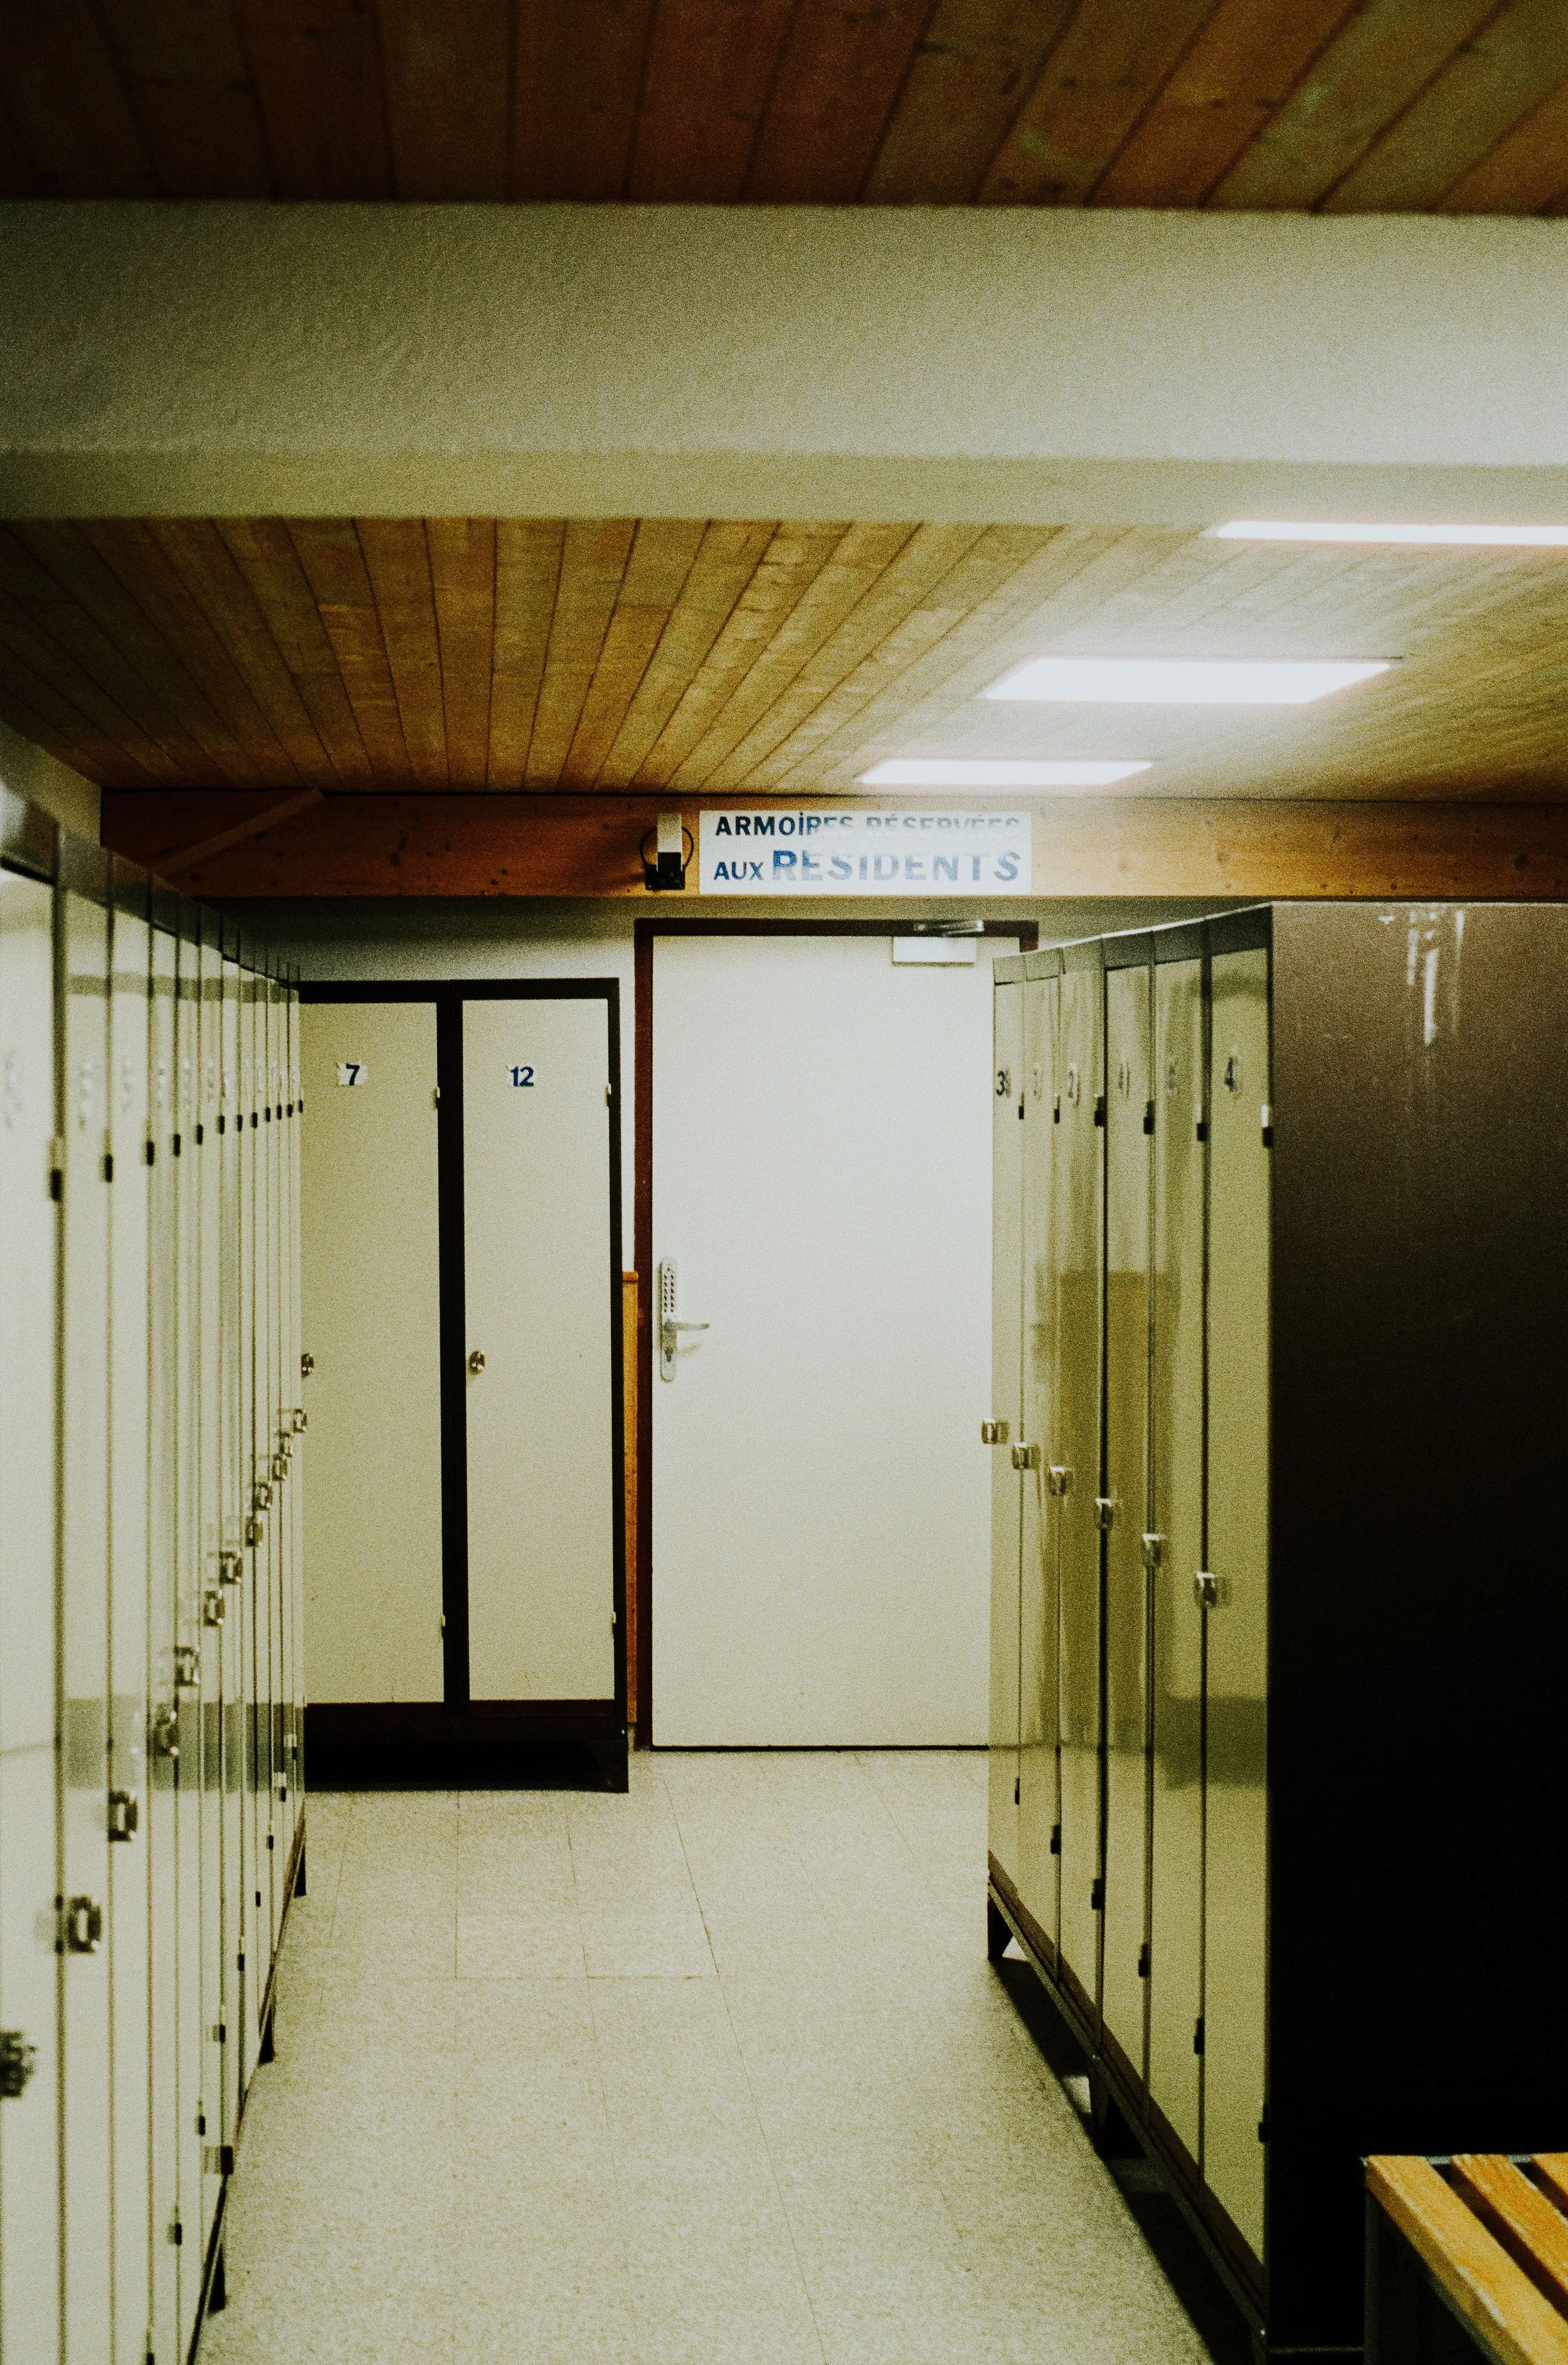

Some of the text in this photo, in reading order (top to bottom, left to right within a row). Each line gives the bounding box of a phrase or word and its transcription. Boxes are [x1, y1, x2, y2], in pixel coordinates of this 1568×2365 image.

[714, 861, 764, 880] AUX
[346, 1063, 360, 1086] 7
[510, 1066, 534, 1087] 12
